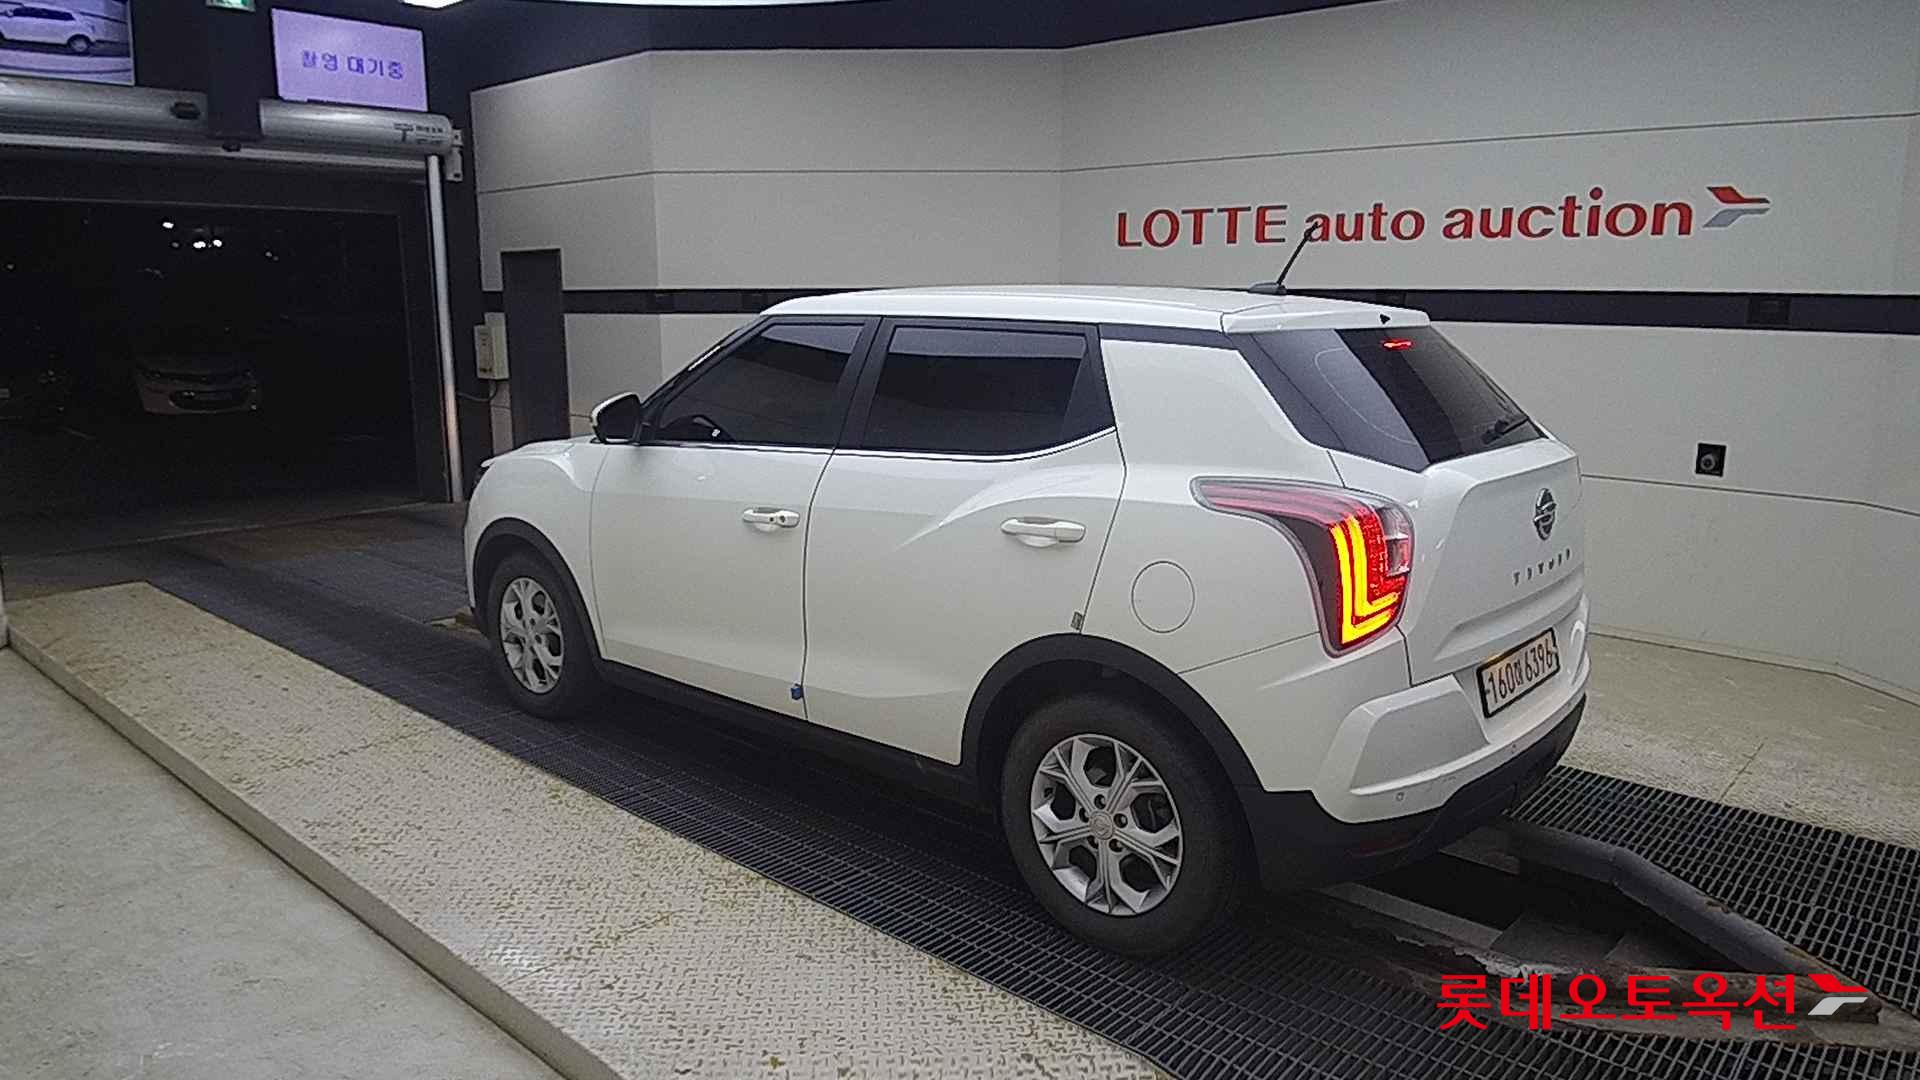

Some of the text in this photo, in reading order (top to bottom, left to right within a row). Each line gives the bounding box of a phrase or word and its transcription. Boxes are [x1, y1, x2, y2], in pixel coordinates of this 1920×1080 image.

[1118, 187, 1692, 247] LOTTE auto auction
